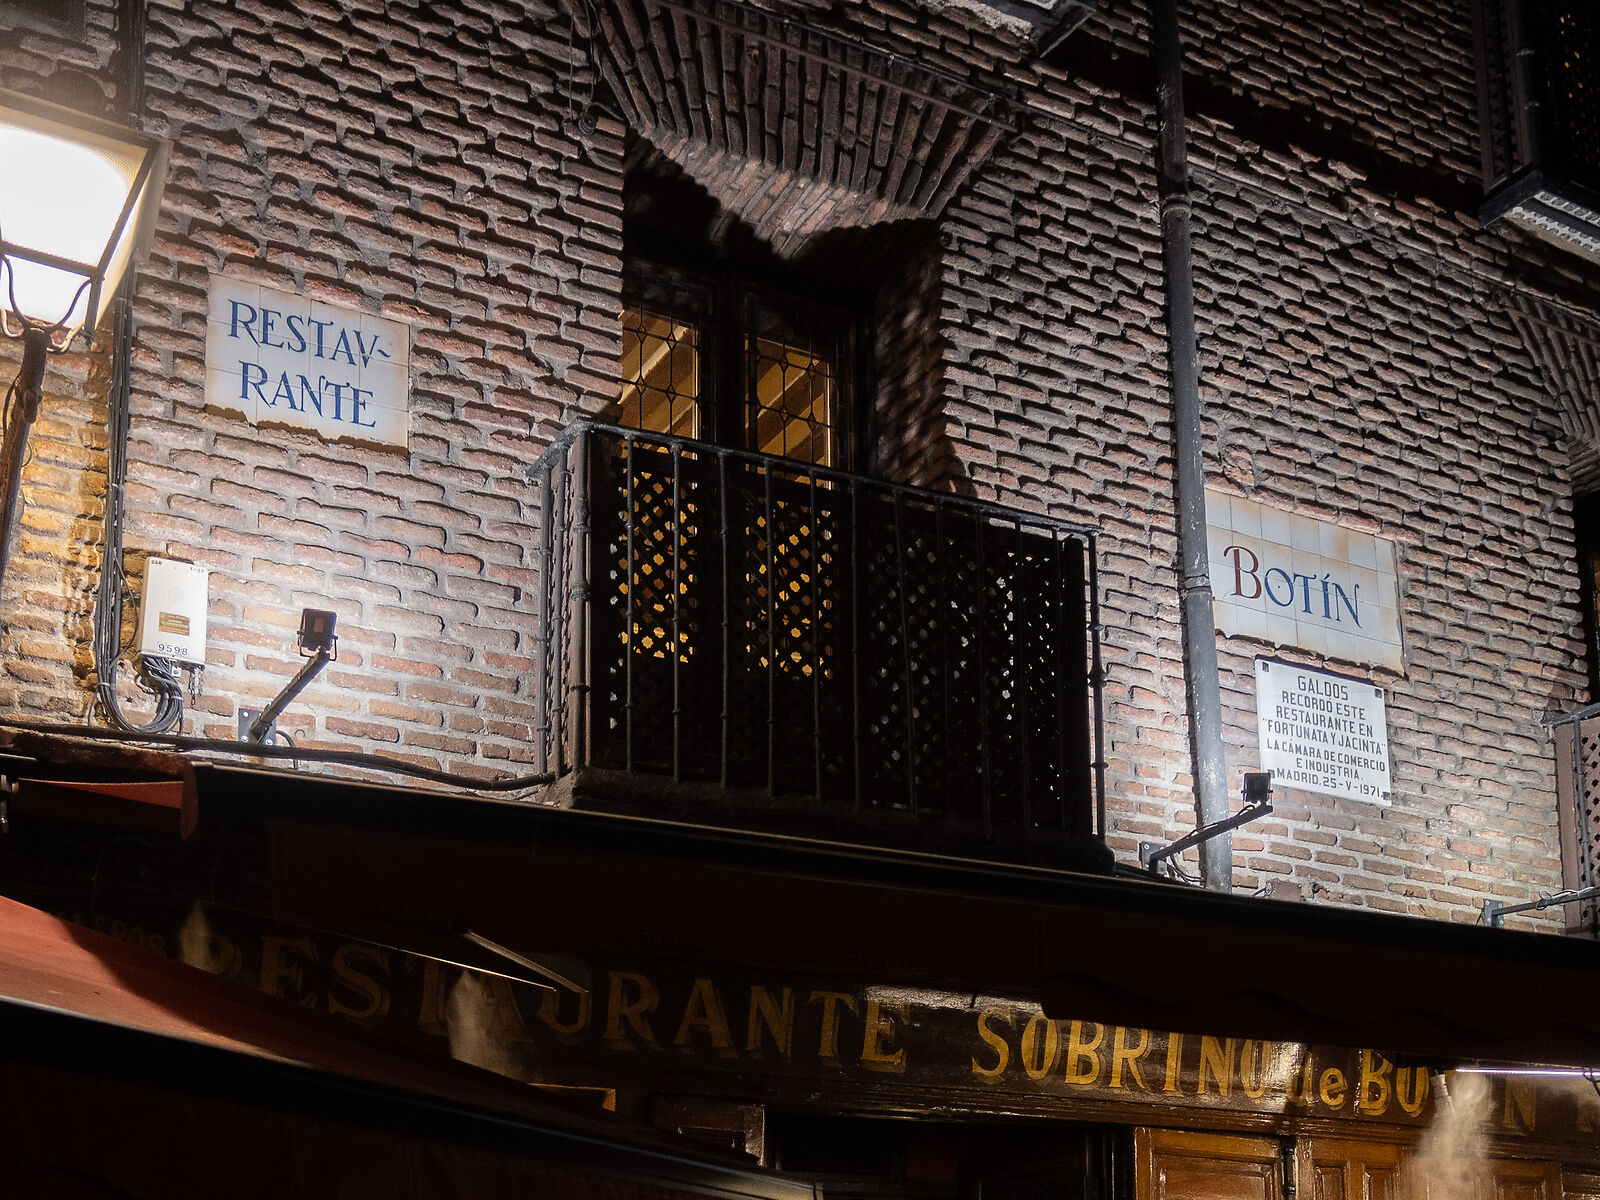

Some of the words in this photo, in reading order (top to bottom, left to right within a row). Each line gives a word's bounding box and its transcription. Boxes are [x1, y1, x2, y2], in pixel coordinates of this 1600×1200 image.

[238, 360, 376, 428] RANTE
[1223, 545, 1362, 628] BOTÍN
[158, 643, 188, 656] 9598
[1297, 675, 1348, 700] GALDOS
[1276, 705, 1356, 734] RESTAURANTE
[1359, 723, 1373, 738] EN
[1282, 690, 1333, 713] RECORDÓ
[1336, 702, 1366, 721] ESTE
[1330, 732, 1336, 745] Y
[1267, 738, 1280, 751] LA
[1282, 739, 1321, 759] CÁMARA
[1324, 751, 1336, 762] DE
[1338, 752, 1385, 772] COMERCIO
[1296, 758, 1303, 769] E
[1305, 760, 1363, 781] INDUSTRIA.
[971, 1007, 1273, 1099] SOBRINO
[1287, 1047, 1348, 1106] de
[1360, 1049, 1538, 1135] BON
